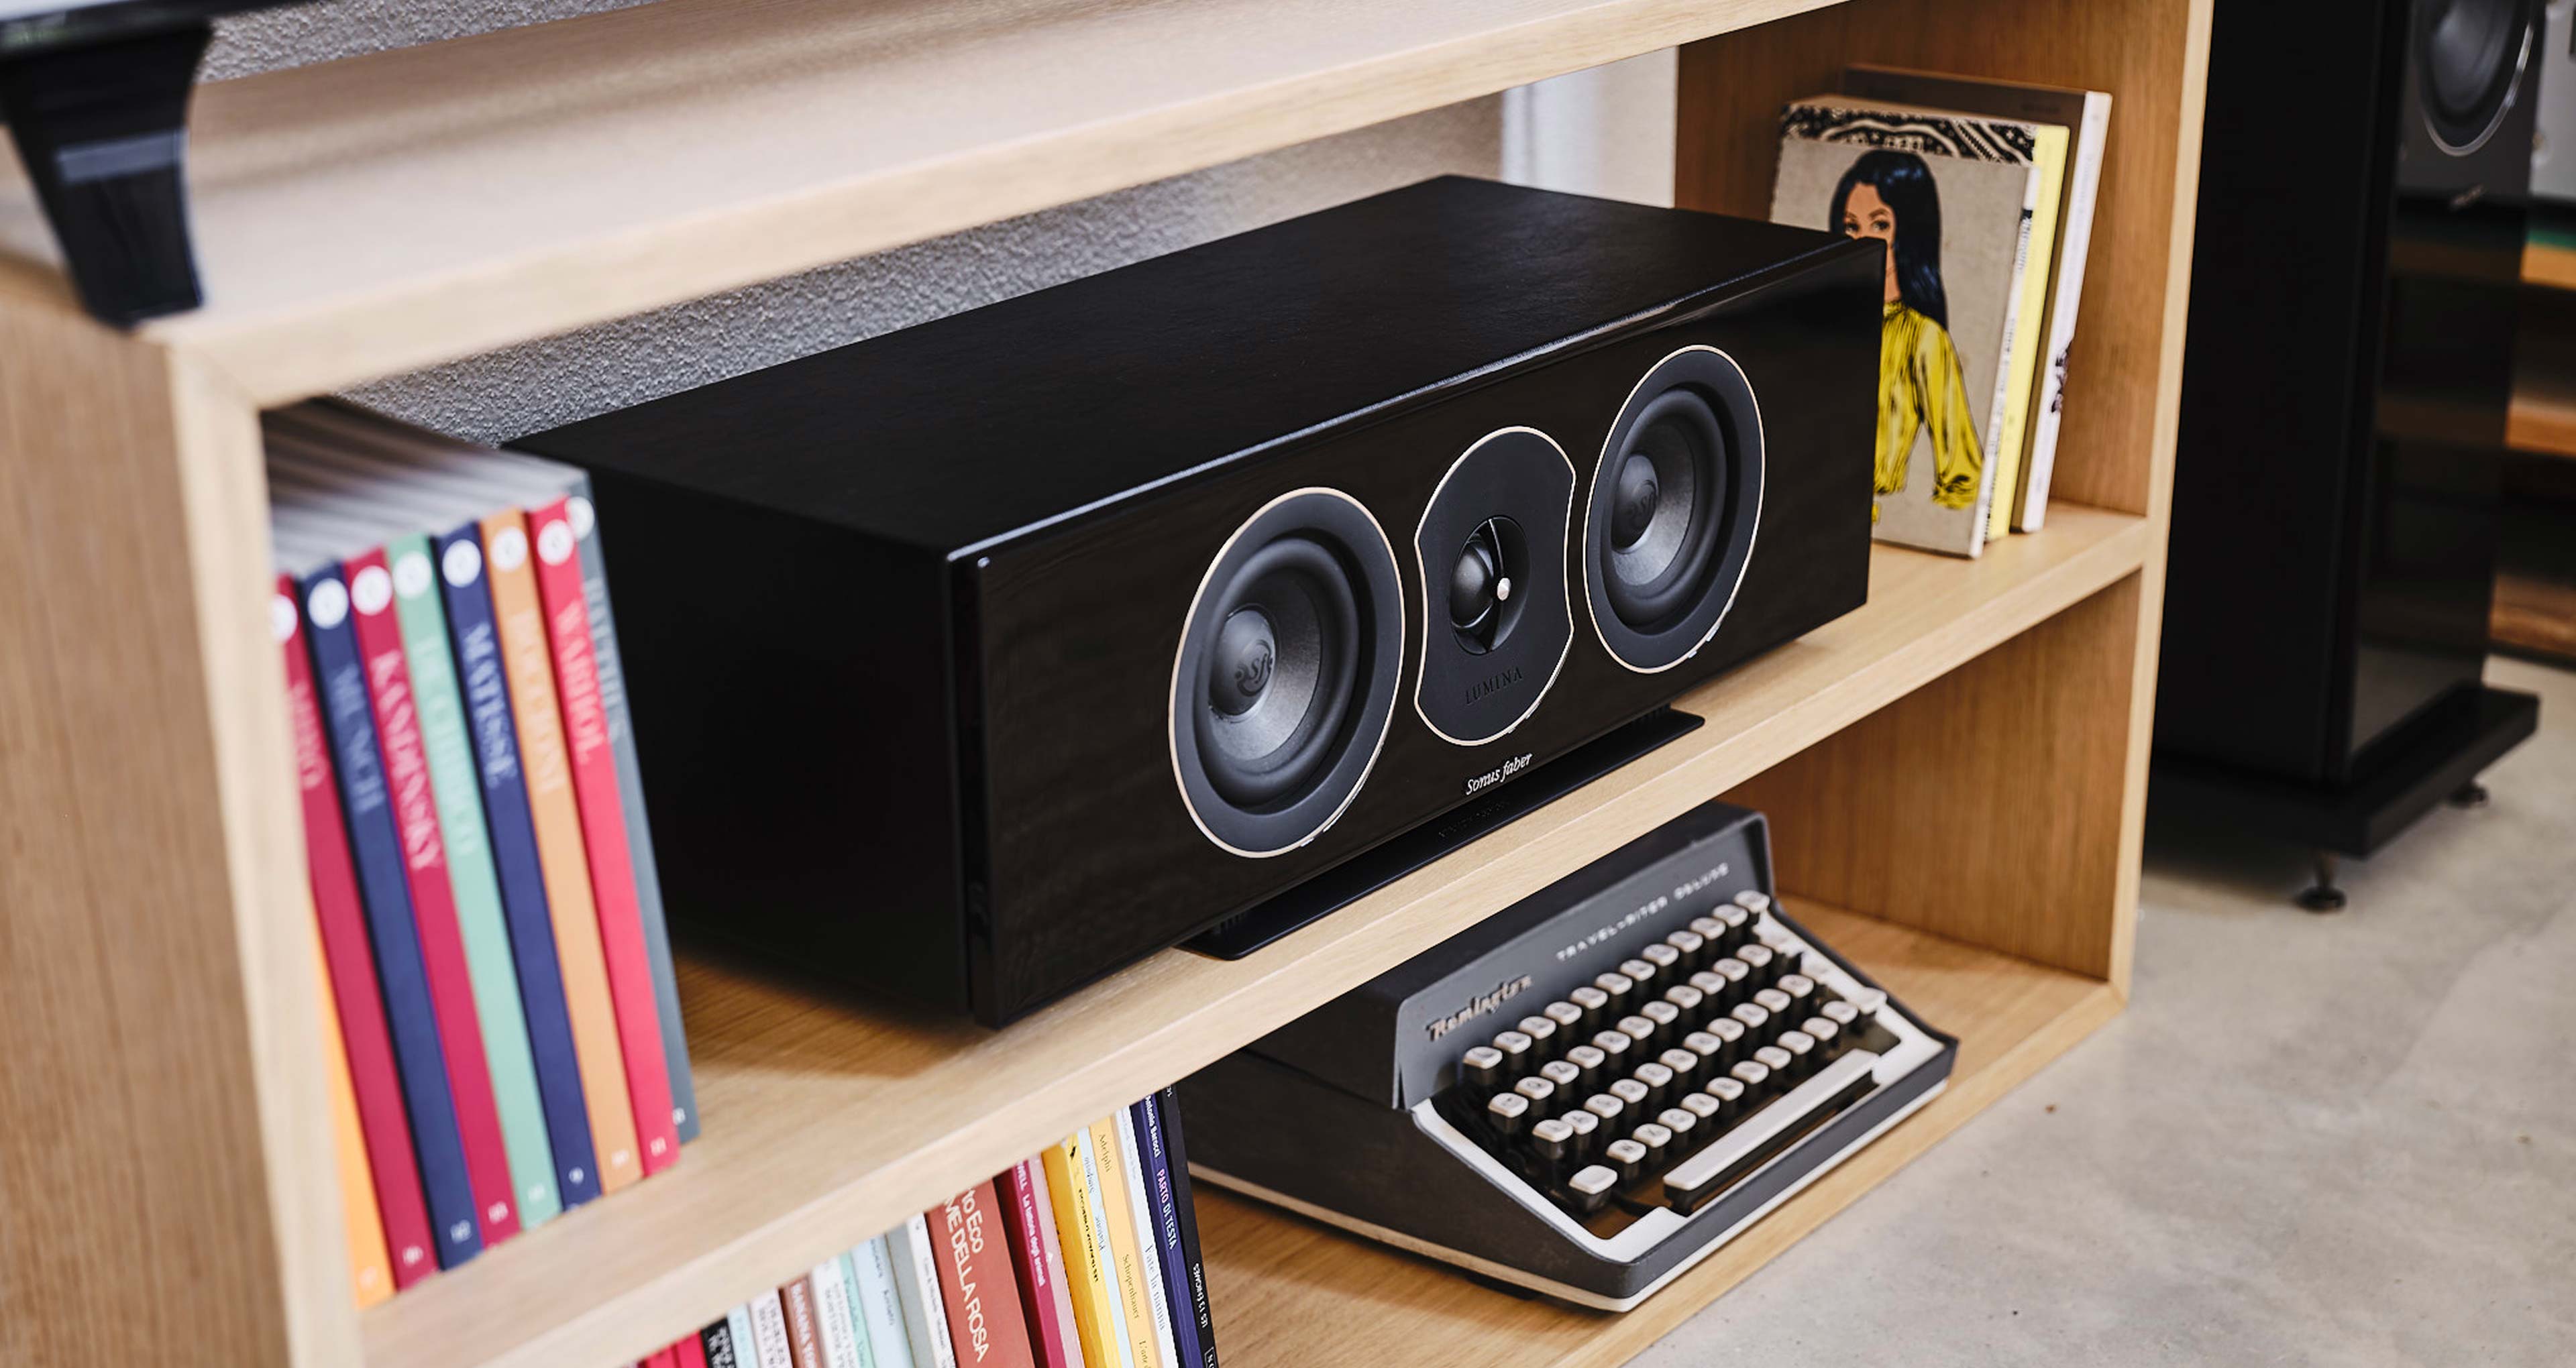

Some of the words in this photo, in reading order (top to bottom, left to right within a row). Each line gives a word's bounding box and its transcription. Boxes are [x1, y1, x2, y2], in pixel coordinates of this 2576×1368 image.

[555, 599, 606, 766] WARHOL
[1465, 666, 1523, 705] LUMINA
[462, 621, 520, 789] MATISSE
[370, 648, 442, 871] KANDINSKY
[1466, 769, 1501, 795] Sonus
[1501, 752, 1533, 783] faber
[1673, 861, 1729, 901] DELUXE
[1426, 974, 1532, 1041] Remington
[1099, 1134, 1112, 1173] Adelphi
[1022, 1194, 1030, 1208] La
[1157, 1168, 1169, 1204] PARTO
[1163, 1202, 1171, 1218] DI
[1165, 1215, 1177, 1250] TESTA
[1145, 1245, 1155, 1273] Fate
[951, 1227, 976, 1302] DELLA
[966, 1297, 989, 1363] ROSA
[1123, 1253, 1139, 1319] Schopenhauer
[1150, 1274, 1159, 1288] la
[1154, 1291, 1165, 1331] nanna
